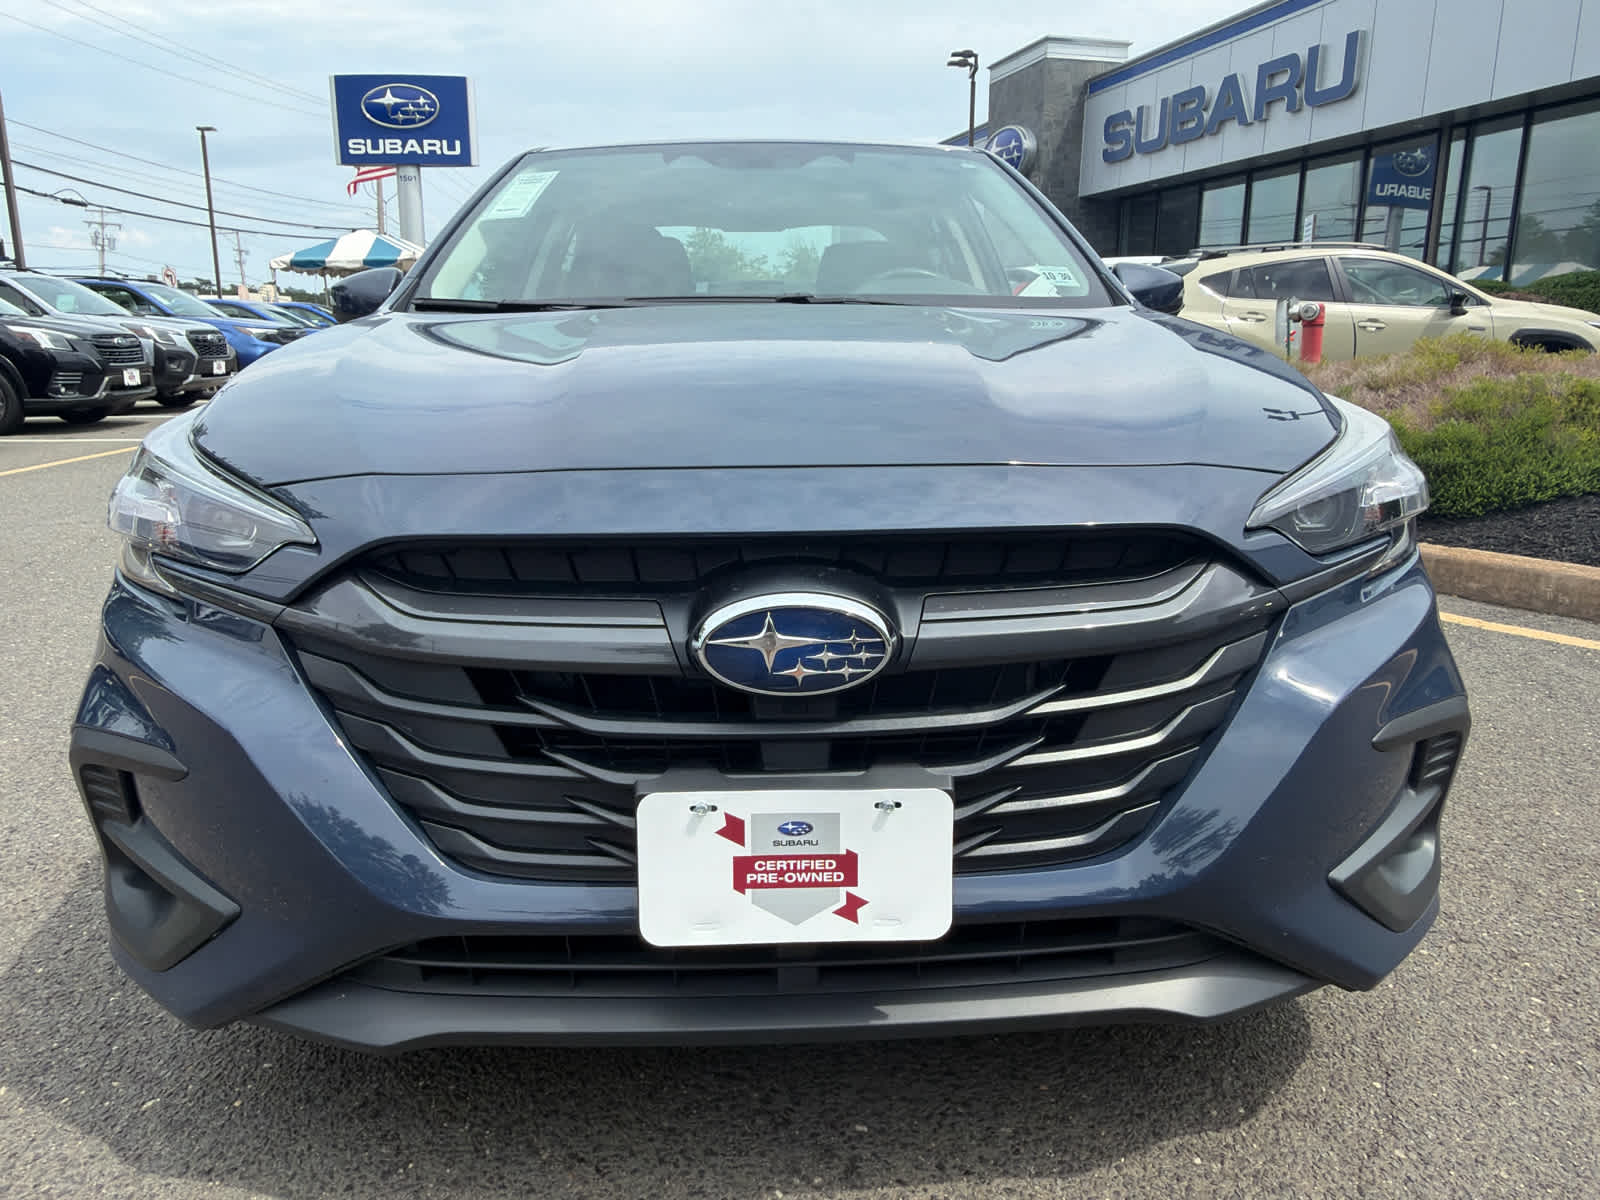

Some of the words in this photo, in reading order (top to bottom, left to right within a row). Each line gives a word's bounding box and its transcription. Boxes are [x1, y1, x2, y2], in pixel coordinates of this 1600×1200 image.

[1102, 29, 1364, 164] SUBARU
[347, 138, 461, 155] SUBARU
[772, 839, 819, 847] SUBARU
[754, 859, 837, 871] CERTIFIED
[746, 872, 845, 884] PRE-OWNED
